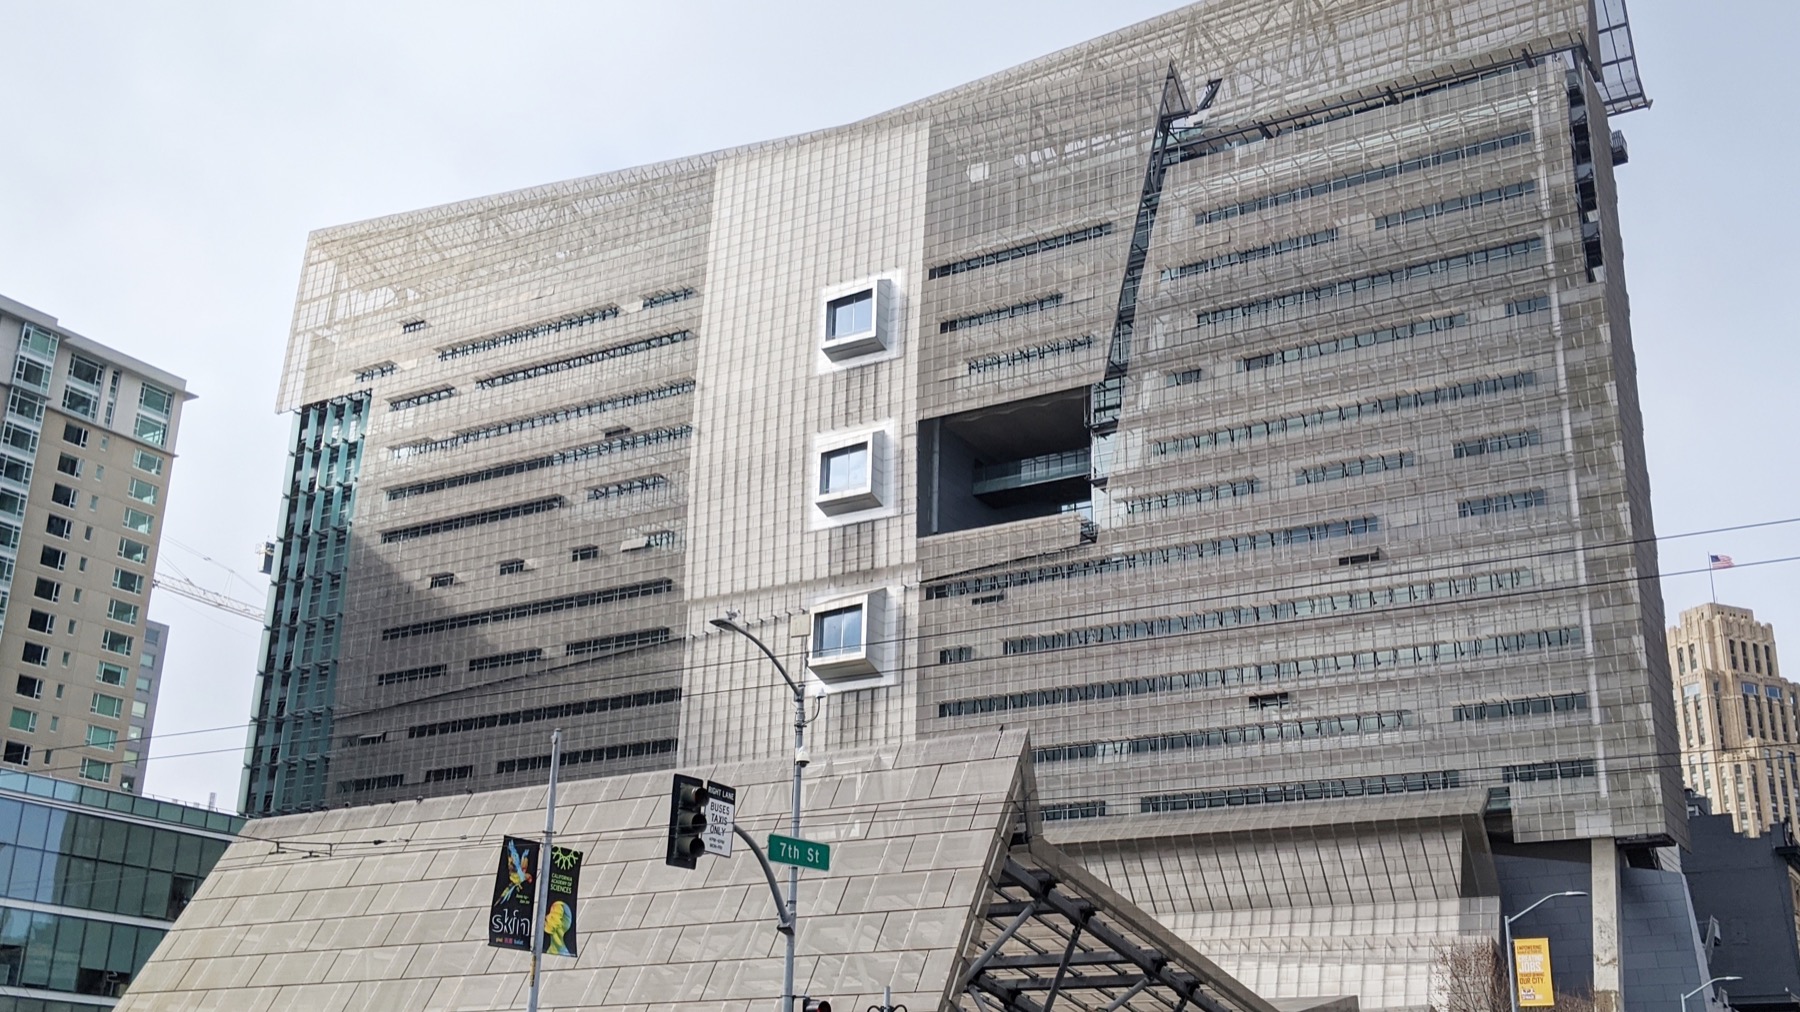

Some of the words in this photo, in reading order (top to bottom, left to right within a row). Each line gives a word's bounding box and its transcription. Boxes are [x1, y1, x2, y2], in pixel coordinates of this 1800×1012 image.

[708, 786, 721, 796] RIGHT
[722, 790, 734, 800] LANE
[710, 802, 730, 815] BUSES
[711, 813, 728, 826] TAXIS
[710, 825, 726, 836] ONLY
[780, 842, 799, 859] 7th
[807, 847, 819, 863] St
[551, 873, 573, 881] CALIFORNIA
[551, 878, 567, 886] ACADEMY
[550, 883, 572, 894] SCIENCES
